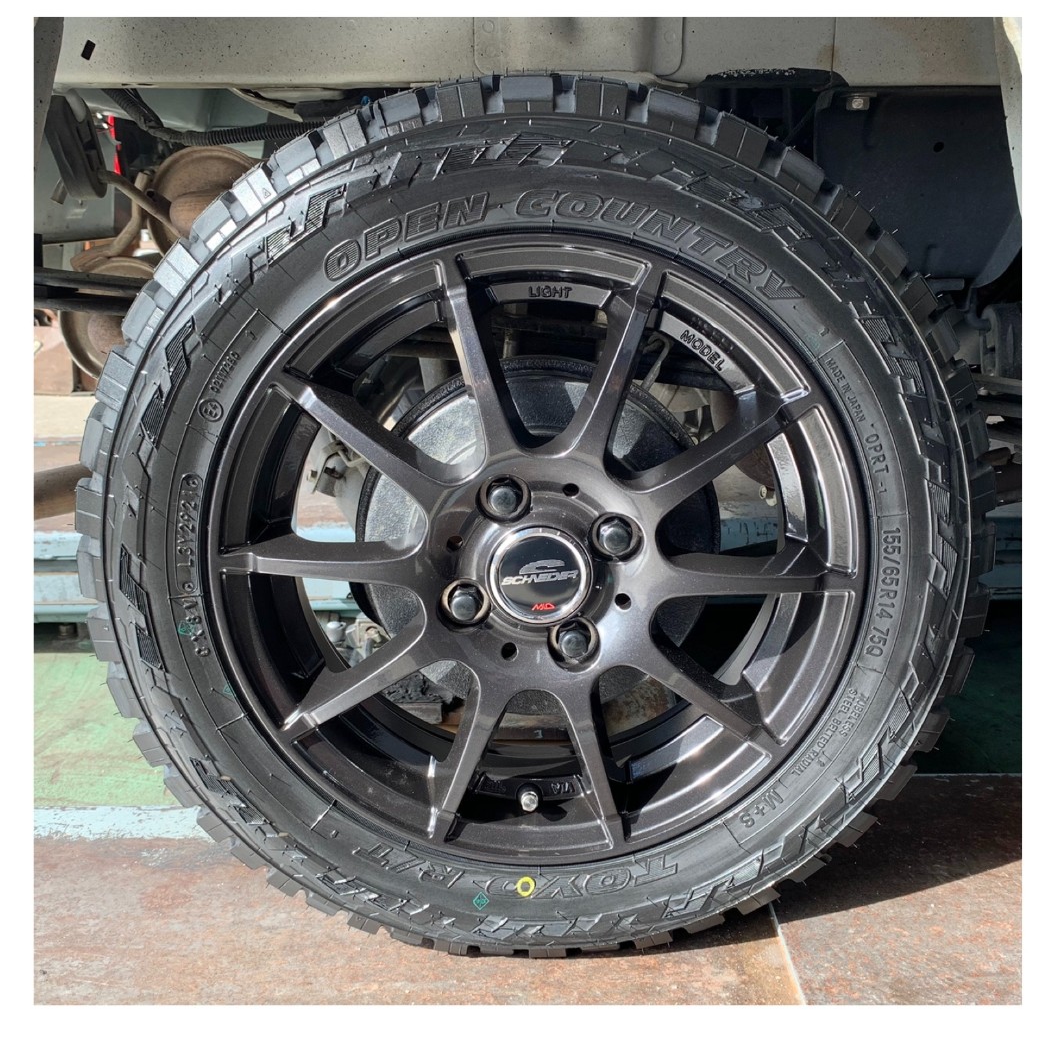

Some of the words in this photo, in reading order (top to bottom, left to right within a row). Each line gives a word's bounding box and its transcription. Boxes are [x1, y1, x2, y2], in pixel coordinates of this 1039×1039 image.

[323, 191, 490, 281] OPEN
[515, 189, 806, 299] COUNTRY
[528, 285, 573, 299] LIGHT
[680, 329, 726, 372] MODEL
[825, 358, 846, 384] MADE
[846, 392, 866, 423] JAPAN
[865, 433, 889, 474] OPRT
[875, 527, 902, 619] 155/65R14
[864, 626, 890, 658] 75Q
[838, 687, 858, 715] STEEL
[840, 693, 869, 738] TUBELESS
[815, 718, 842, 749] BELTED
[791, 750, 820, 777] RADIAL
[352, 842, 465, 888] R/T
[484, 854, 678, 900] TOYO
